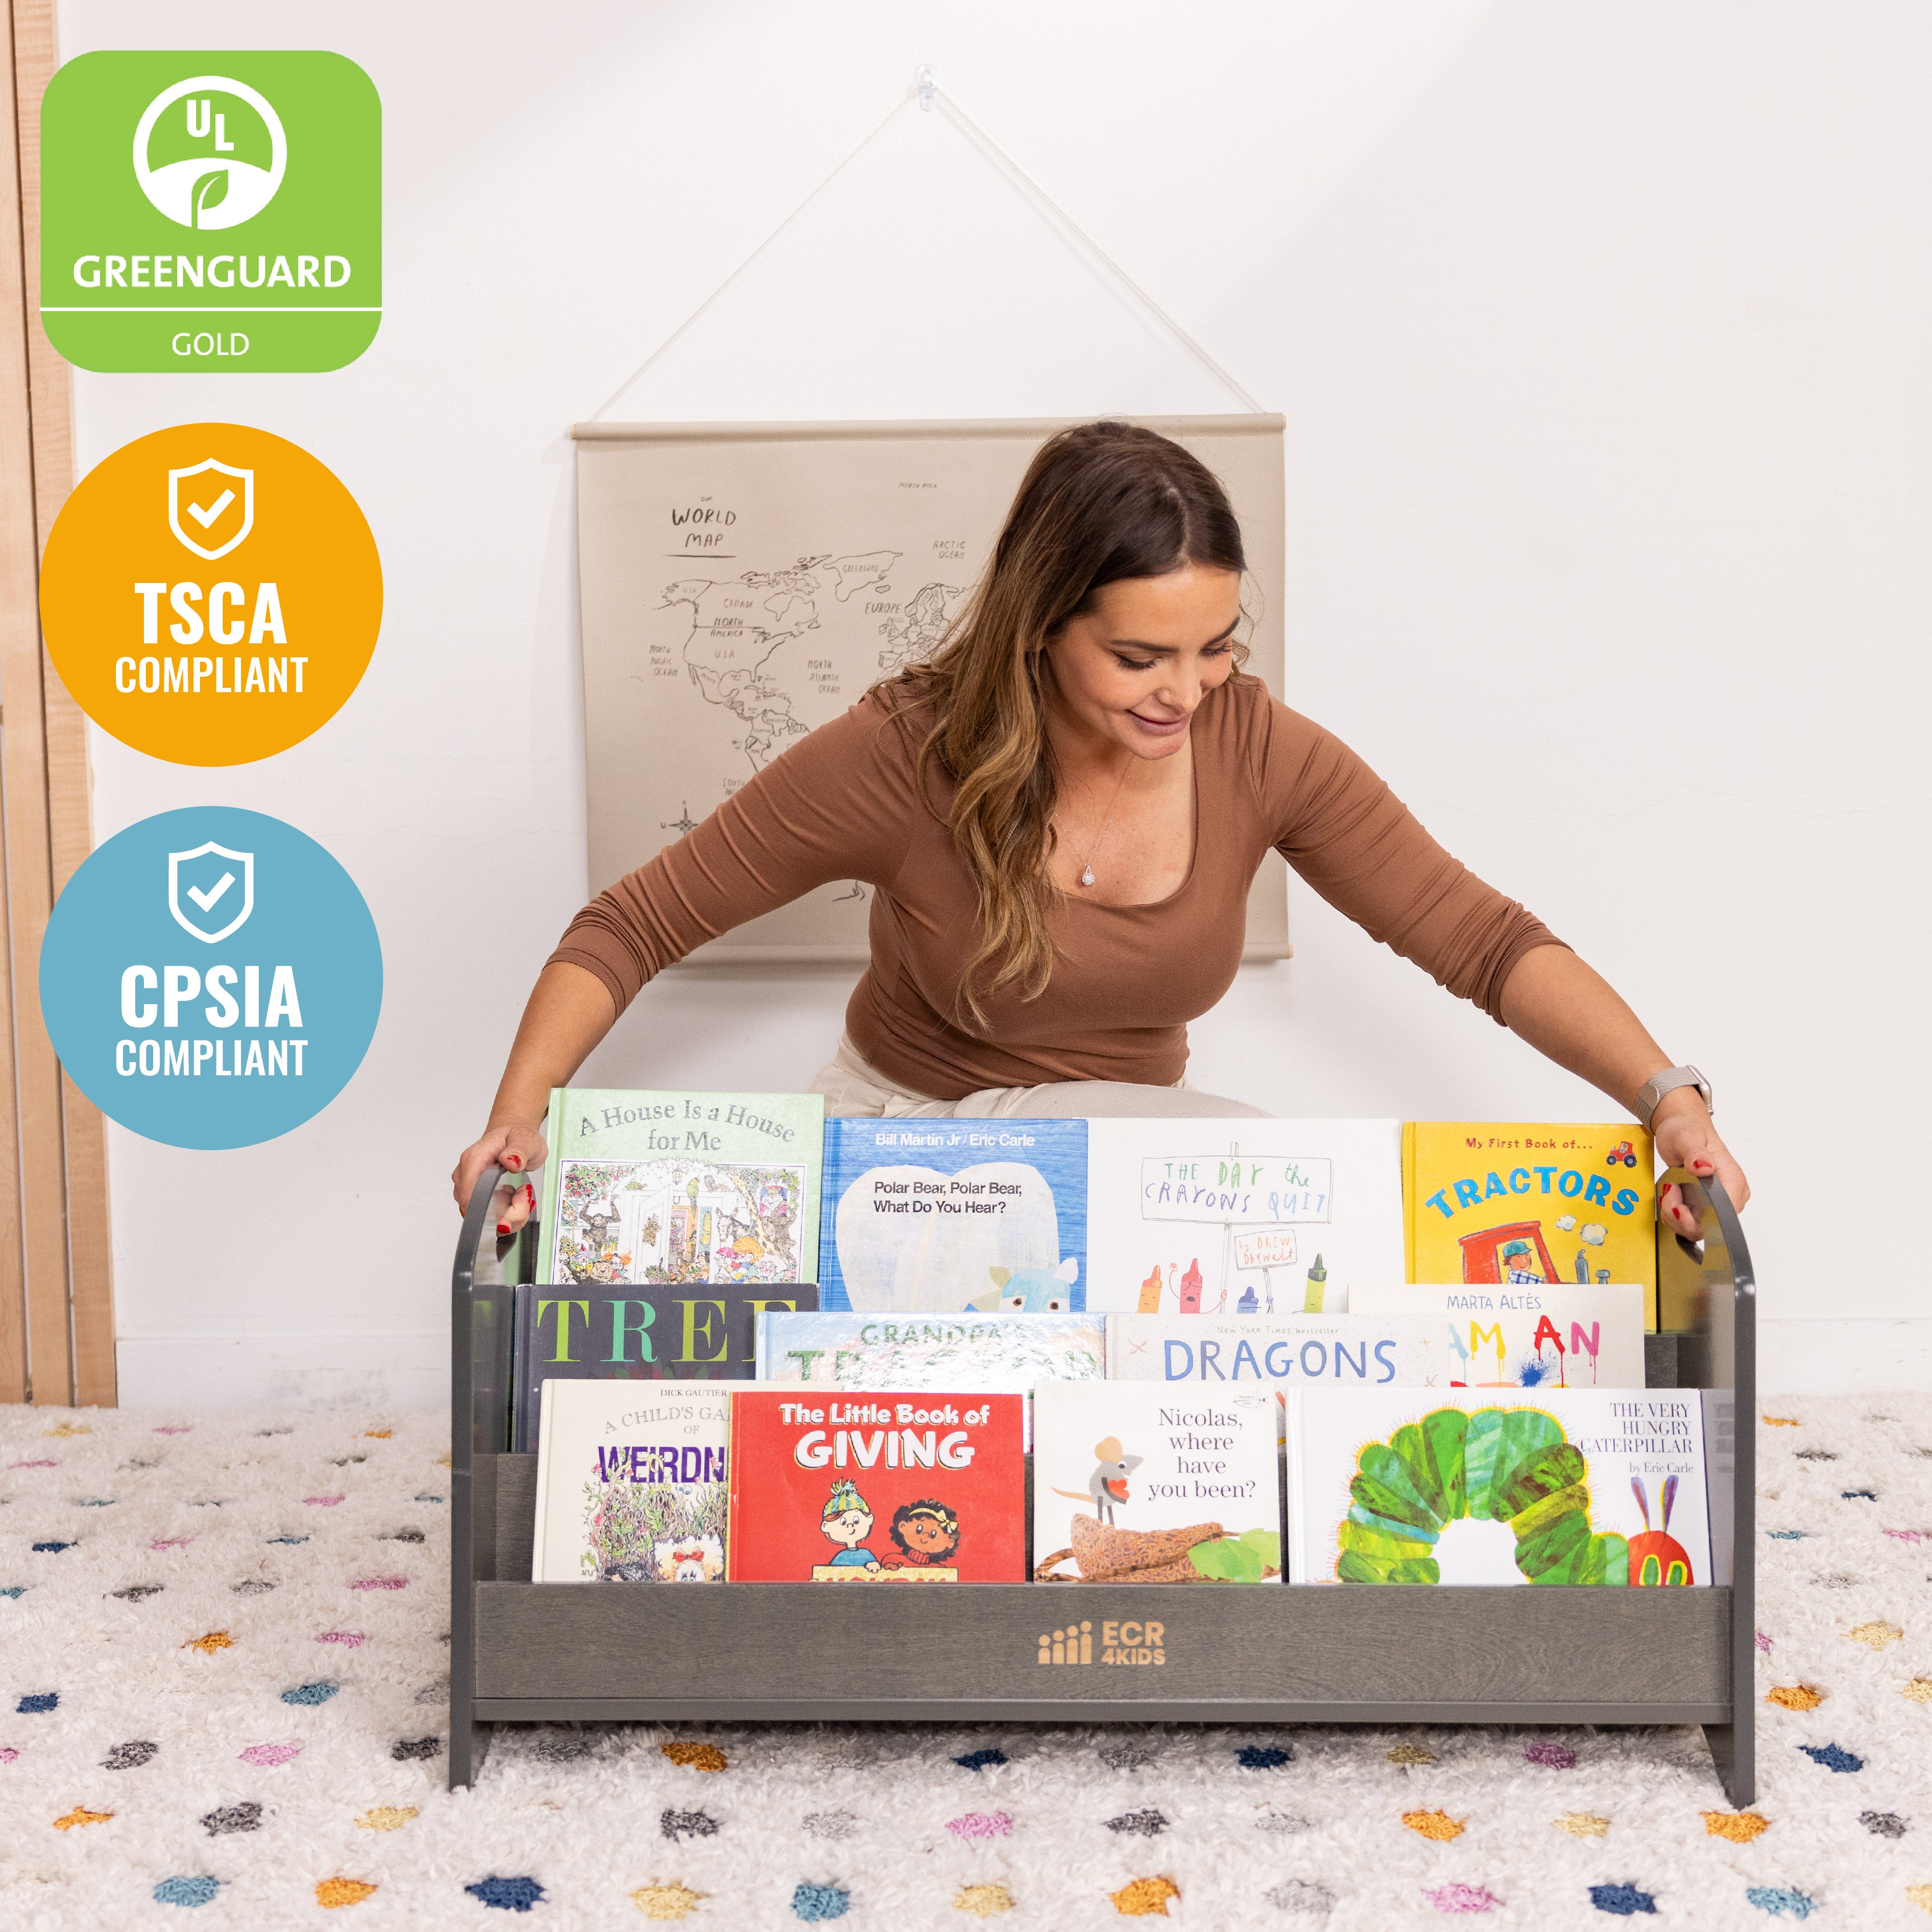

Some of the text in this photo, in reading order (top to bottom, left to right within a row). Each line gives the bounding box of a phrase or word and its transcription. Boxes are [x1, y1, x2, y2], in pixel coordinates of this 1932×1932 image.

[672, 508, 736, 526] WORLD
[685, 533, 723, 547] MAP
[933, 540, 966, 549] ARCTIC
[939, 551, 965, 559] OCEAN
[724, 598, 753, 608] CANADA
[865, 602, 901, 614] EUROPE
[714, 618, 743, 626] NORTH
[710, 629, 743, 638] AMERICA
[807, 660, 832, 669] NORTH
[580, 1100, 795, 1143] A House Is a House
[647, 1129, 722, 1151] for Me
[876, 1133, 897, 1146] Bill
[900, 1133, 943, 1146] Martin
[947, 1133, 962, 1147] Jr
[969, 1133, 995, 1147] Eric
[999, 1133, 1035, 1147] Carle
[1465, 1137, 1593, 1149] My First Book of...
[1165, 1162, 1309, 1188] THE DAY the
[874, 1181, 1022, 1197] Polar Bear, Polar Bear,
[1425, 1166, 1639, 1219] TRACTORS
[873, 1200, 1006, 1214] What Do You Hear?
[1145, 1182, 1326, 1220] CRAYONS QUIT
[1257, 1236, 1291, 1249] DREW
[1448, 1293, 1541, 1310] MARTA ALTÉS
[1534, 1315, 1600, 1368] AN
[1164, 1339, 1396, 1384] DRAGONS
[779, 1404, 990, 1426] The Little Book of
[1159, 1408, 1243, 1430] Nicolas,
[1610, 1403, 1690, 1418] THE VERY
[605, 1406, 730, 1434] A CHILD'S GA
[1623, 1421, 1691, 1435] HUNGRY
[684, 1425, 700, 1435] OF
[794, 1429, 975, 1469] GIVING
[1169, 1433, 1234, 1450] where
[1581, 1438, 1692, 1453] CATERPILLAR
[598, 1446, 729, 1483] WEIRDN
[1177, 1456, 1226, 1474] have
[1629, 1462, 1694, 1476] by Eric Carle
[1148, 1481, 1256, 1501] you been?
[1103, 1621, 1165, 1646] ECR
[1101, 1648, 1166, 1665] 4KIDS
